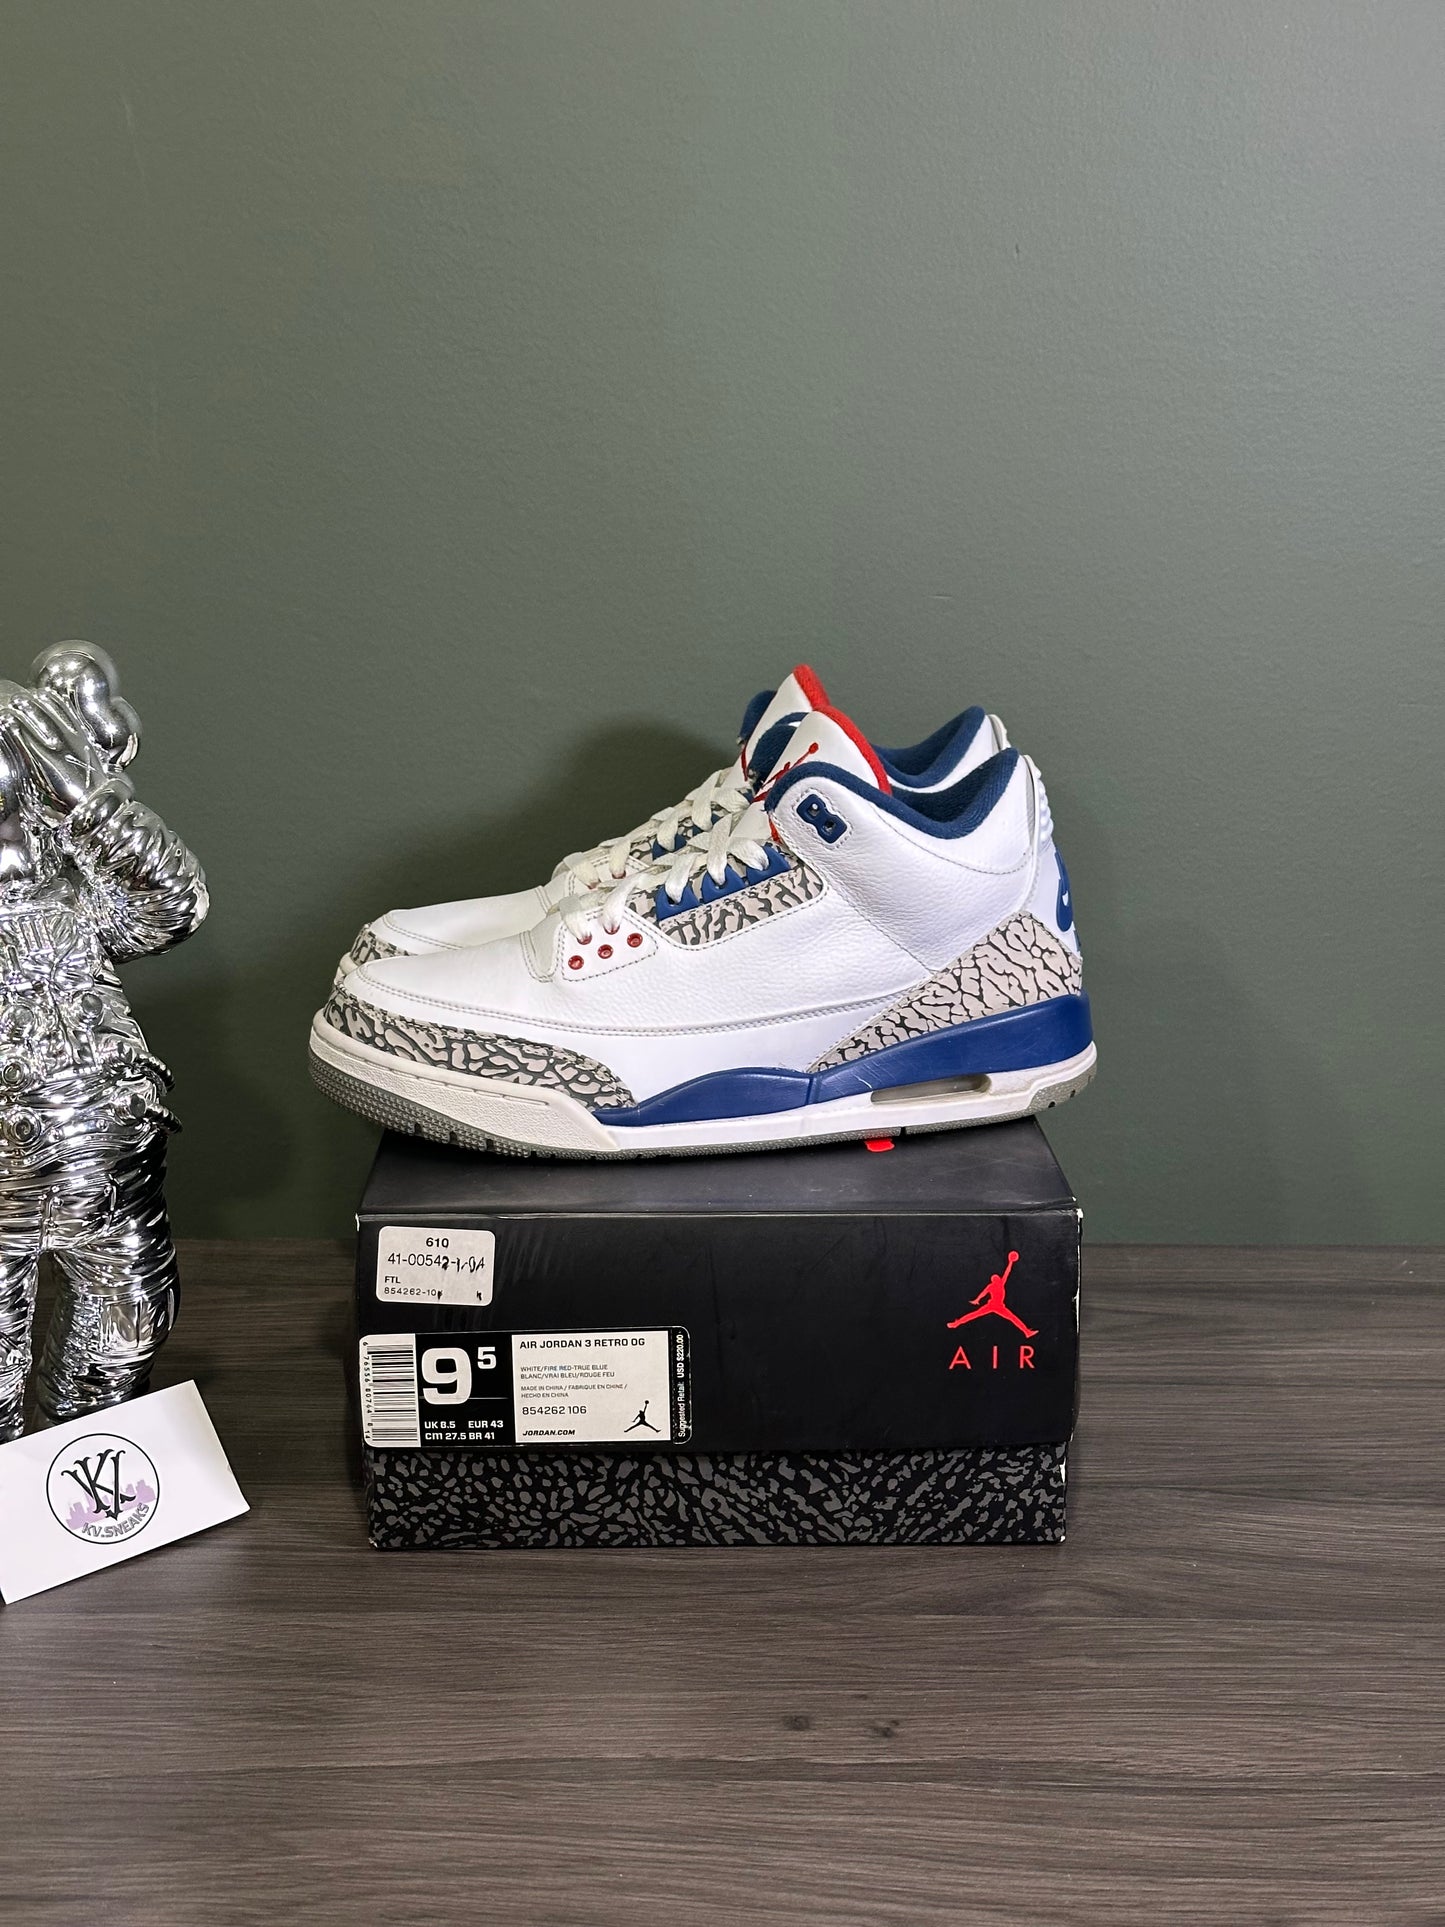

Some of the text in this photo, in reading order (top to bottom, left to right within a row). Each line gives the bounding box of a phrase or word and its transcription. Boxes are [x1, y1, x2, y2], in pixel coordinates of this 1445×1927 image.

[426, 1237, 449, 1248] 610
[384, 1276, 401, 1284] FTL
[519, 1337, 646, 1350] AIR JORDAN 3 RETRO OG
[676, 1334, 685, 1361] $220.00
[948, 1345, 1036, 1370] AIR
[421, 1346, 497, 1405] 9 5
[676, 1362, 685, 1378] USD
[424, 1420, 504, 1429] UK 8.5 EUR 43
[678, 1402, 688, 1437] Suggested
[445, 1432, 467, 1440] 27.5
[469, 1432, 483, 1440] BR
[484, 1432, 495, 1440] 41
[81, 1502, 150, 1538] KV.SNEAKS
